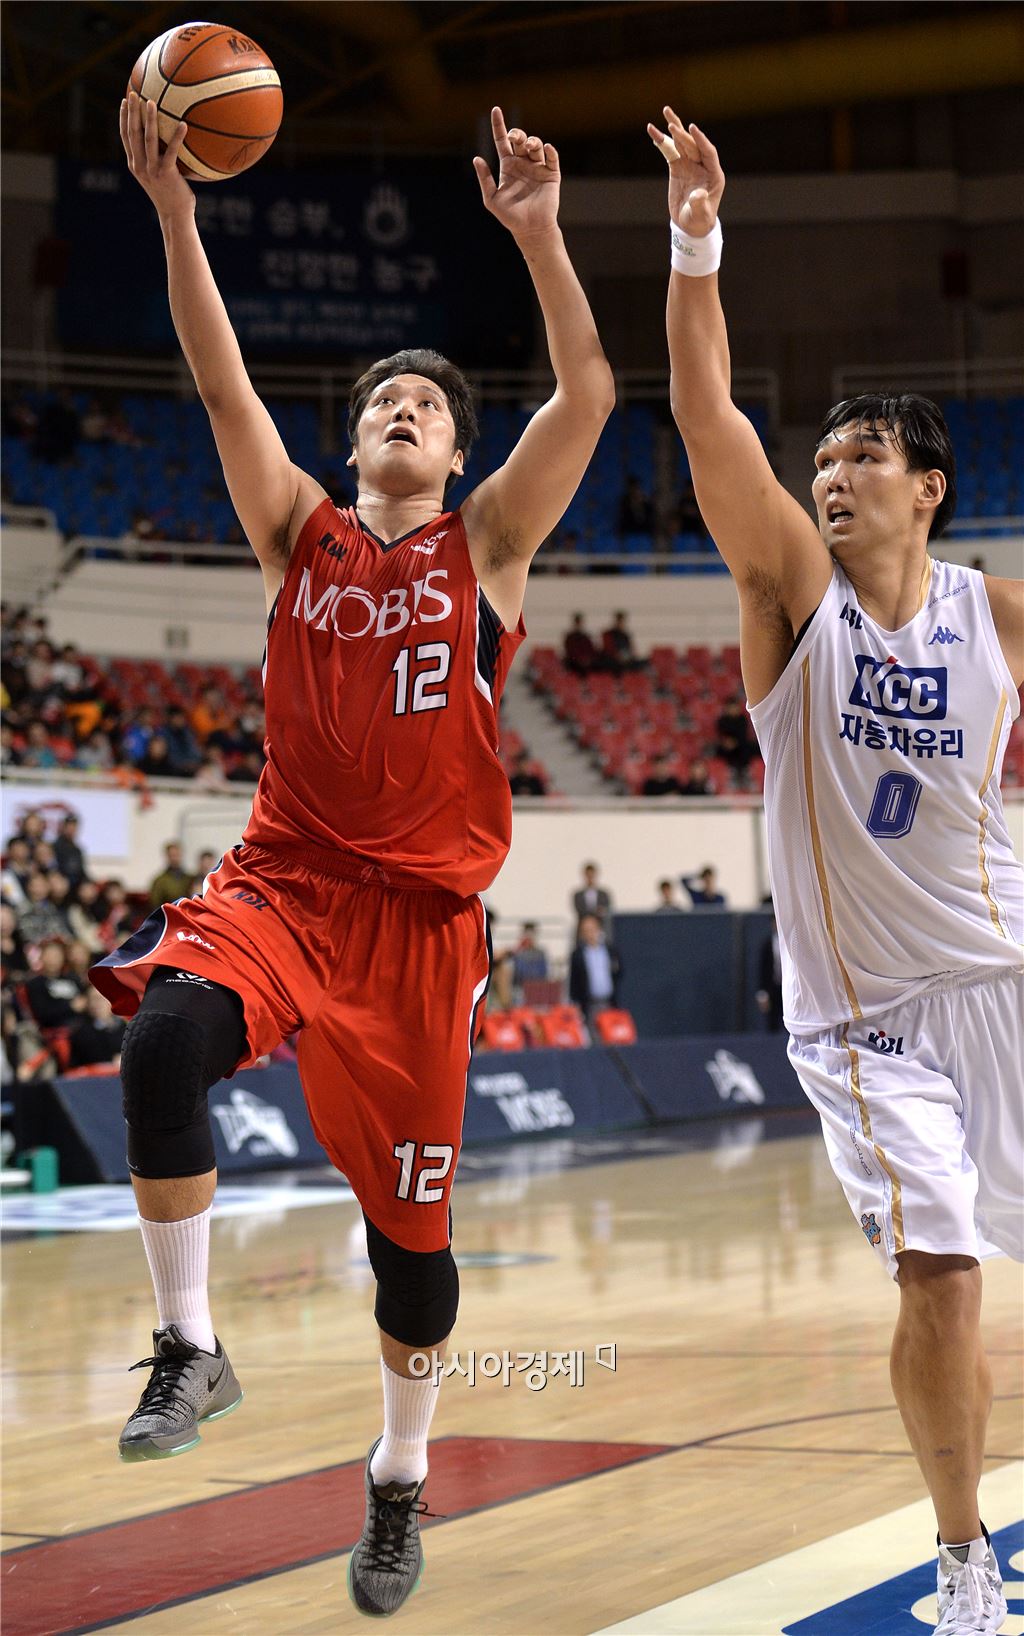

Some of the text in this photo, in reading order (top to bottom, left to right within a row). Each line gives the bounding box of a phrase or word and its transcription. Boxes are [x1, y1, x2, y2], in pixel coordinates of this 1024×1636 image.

[292, 566, 453, 641] MOBIS
[392, 640, 450, 716] 12
[860, 657, 939, 715] KCC
[839, 712, 964, 759] 자동차유리
[866, 769, 923, 839] 0
[393, 1140, 454, 1204] 12
